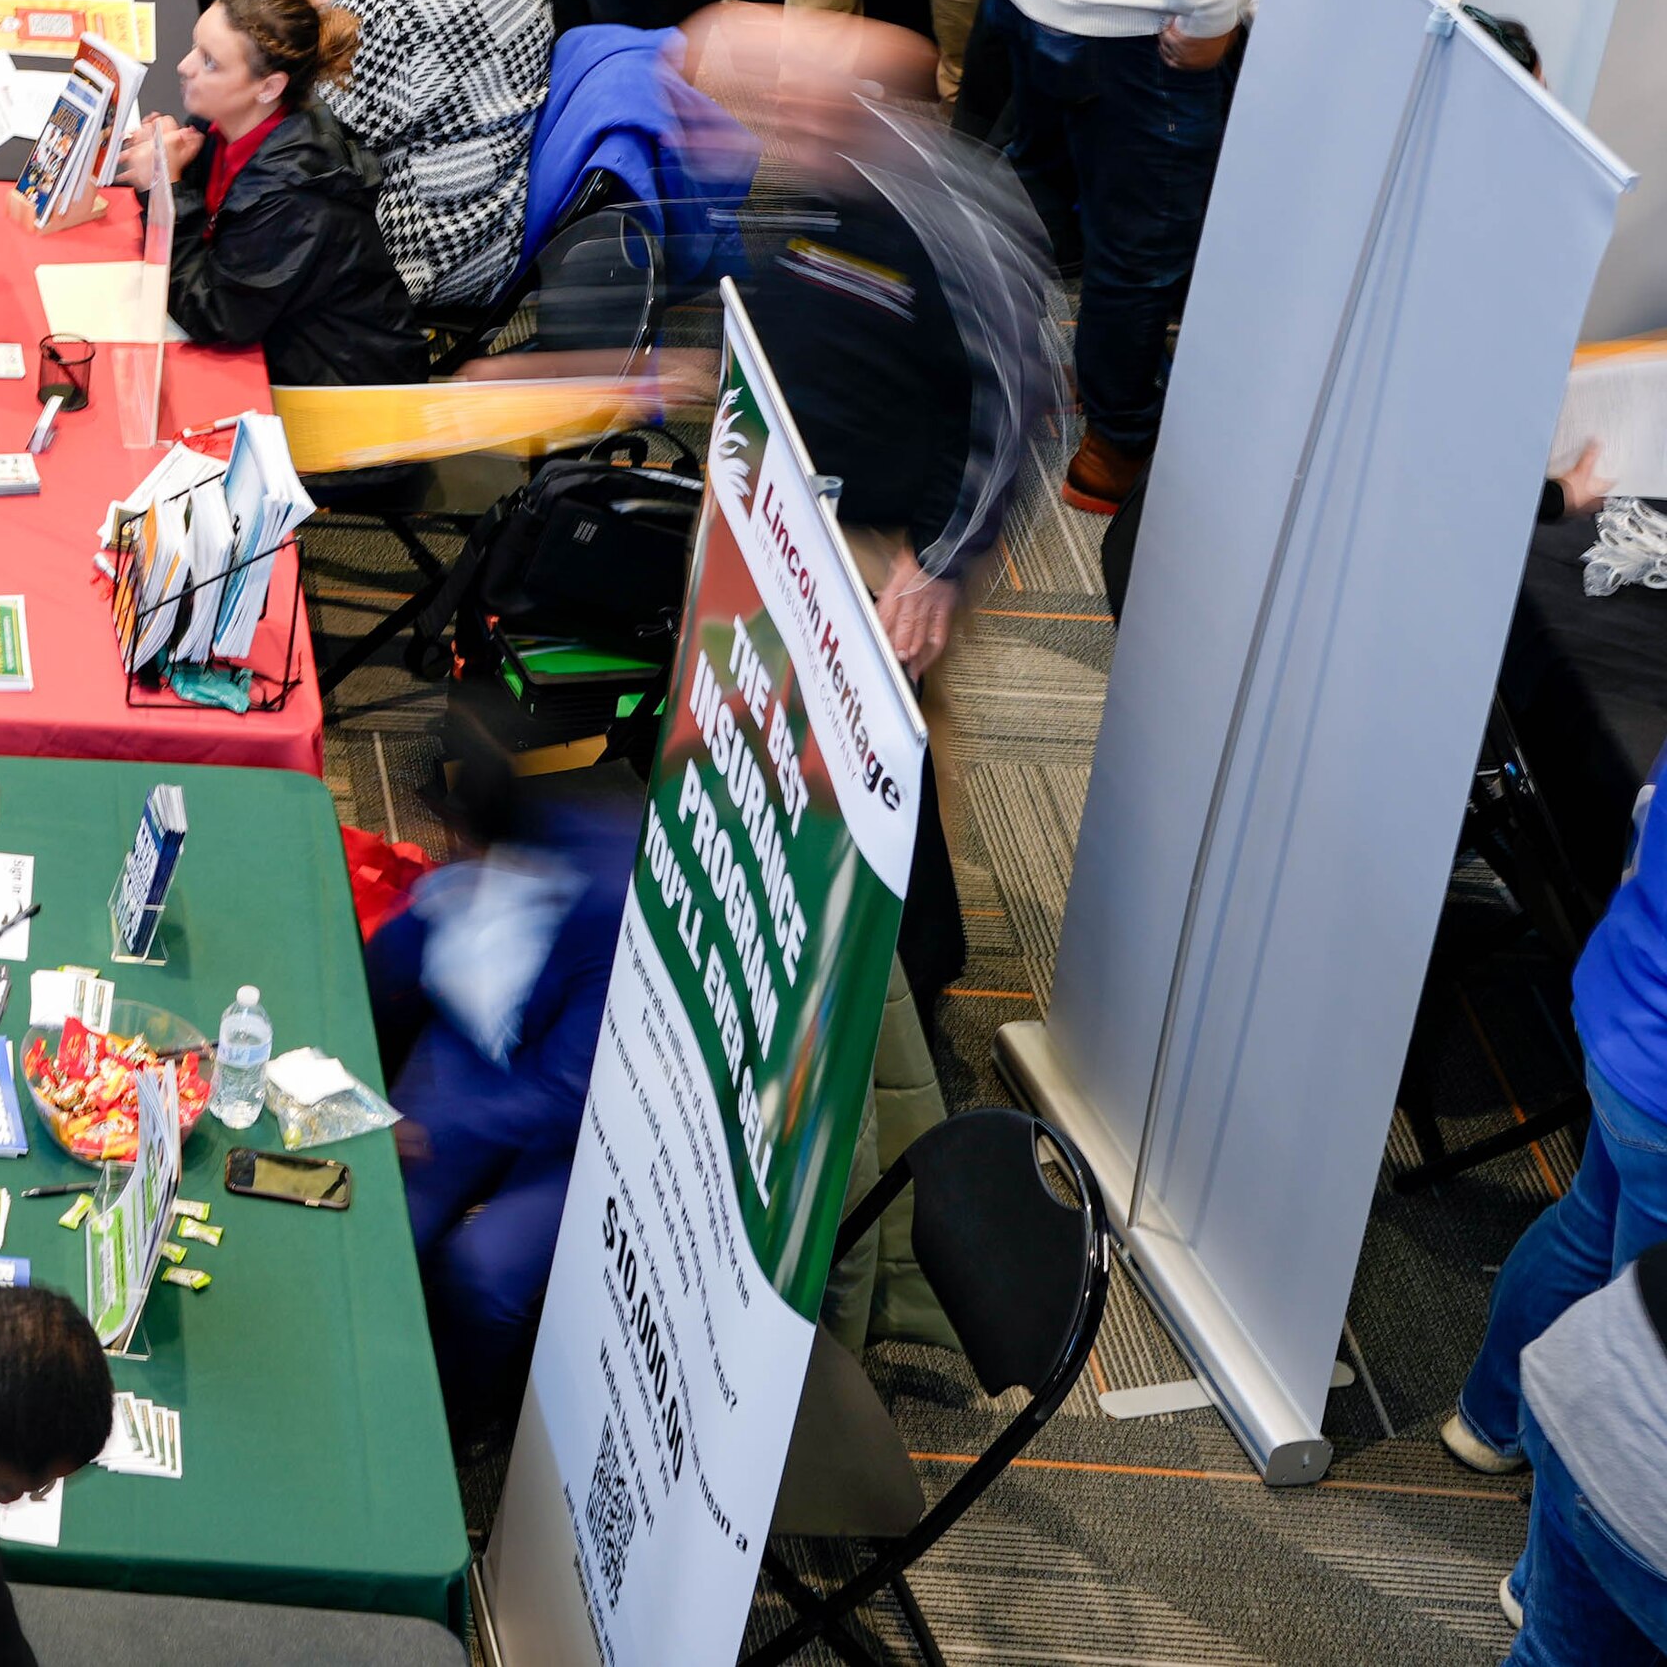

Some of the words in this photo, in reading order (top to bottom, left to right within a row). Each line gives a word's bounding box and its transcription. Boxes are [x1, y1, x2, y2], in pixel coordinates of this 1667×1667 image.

[728, 607, 772, 733] THE
[767, 693, 809, 843] BEST
[754, 520, 774, 575] LIFE
[774, 564, 820, 688] INSURANCE
[818, 676, 857, 787] COMPANY
[762, 481, 824, 639] Lincoln
[820, 620, 902, 816] Heritage
[677, 751, 779, 1065] PROGRAM
[688, 643, 808, 994] INSURANCE
[631, 941, 666, 1031] generate
[665, 1016, 694, 1100] millions
[692, 1085, 701, 1119] of
[699, 1103, 721, 1195] branded
[728, 1234, 737, 1276] for
[735, 1263, 750, 1312] the
[641, 1003, 672, 1089] Funeral
[669, 1071, 705, 1184] Advantage
[643, 796, 707, 979] YOU'LL
[702, 937, 744, 1091] EVER
[736, 1059, 775, 1214] SELL
[615, 1031, 638, 1098] many
[637, 1080, 660, 1147] could
[658, 1134, 672, 1182] you
[671, 1169, 681, 1209] be
[680, 1200, 702, 1291] working
[700, 1275, 706, 1309] in
[648, 1159, 664, 1212] Find
[662, 1202, 674, 1245] out
[599, 1336, 621, 1422] Watch
[635, 1465, 654, 1539] now!
[600, 1185, 685, 1488] $10,000.00
[602, 1264, 630, 1356] monthly
[629, 1344, 652, 1426] income
[651, 1413, 661, 1457] for
[658, 1452, 670, 1501] you
[604, 1140, 619, 1185] our
[619, 1172, 665, 1312] one-of-a-kind
[662, 1302, 678, 1364] sales
[690, 1426, 700, 1478] can
[699, 1470, 731, 1542] mean
[735, 1527, 748, 1557] a
